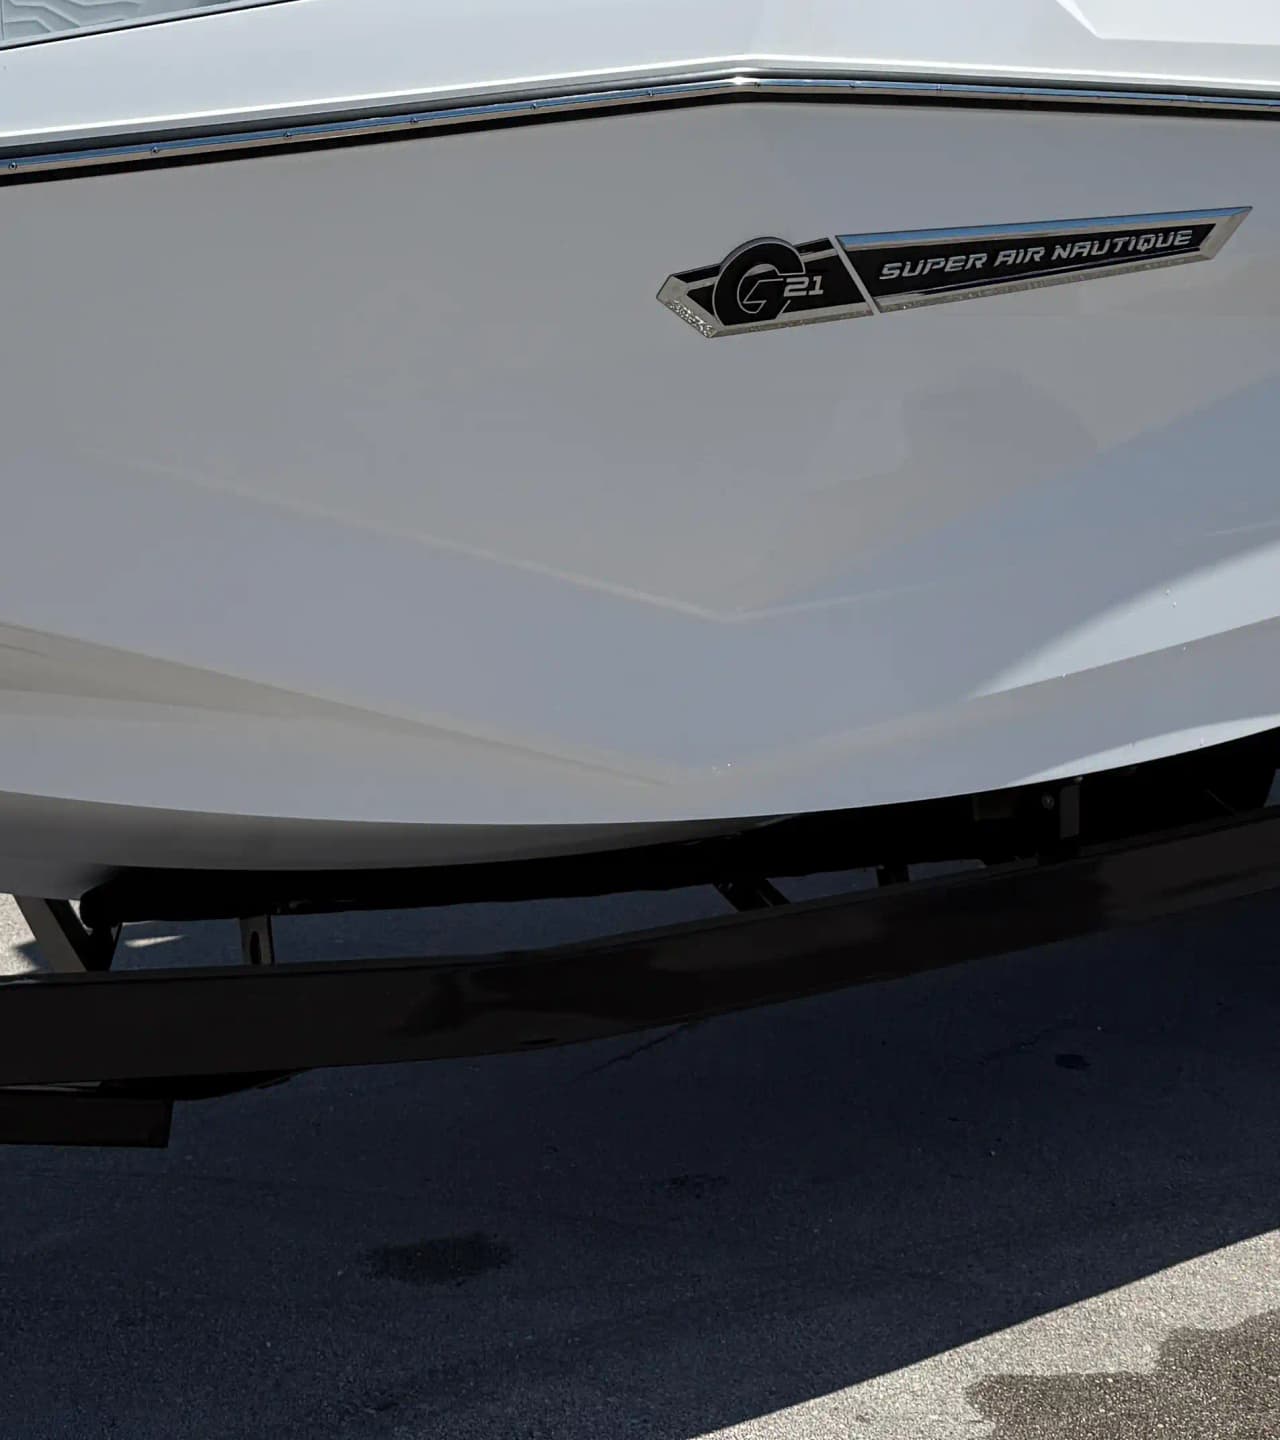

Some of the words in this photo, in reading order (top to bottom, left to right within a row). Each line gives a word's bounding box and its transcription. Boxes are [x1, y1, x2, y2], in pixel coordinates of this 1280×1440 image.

[879, 253, 988, 280] SUPER
[993, 247, 1046, 267] AIR
[1052, 230, 1193, 259] NAUTIQUE
